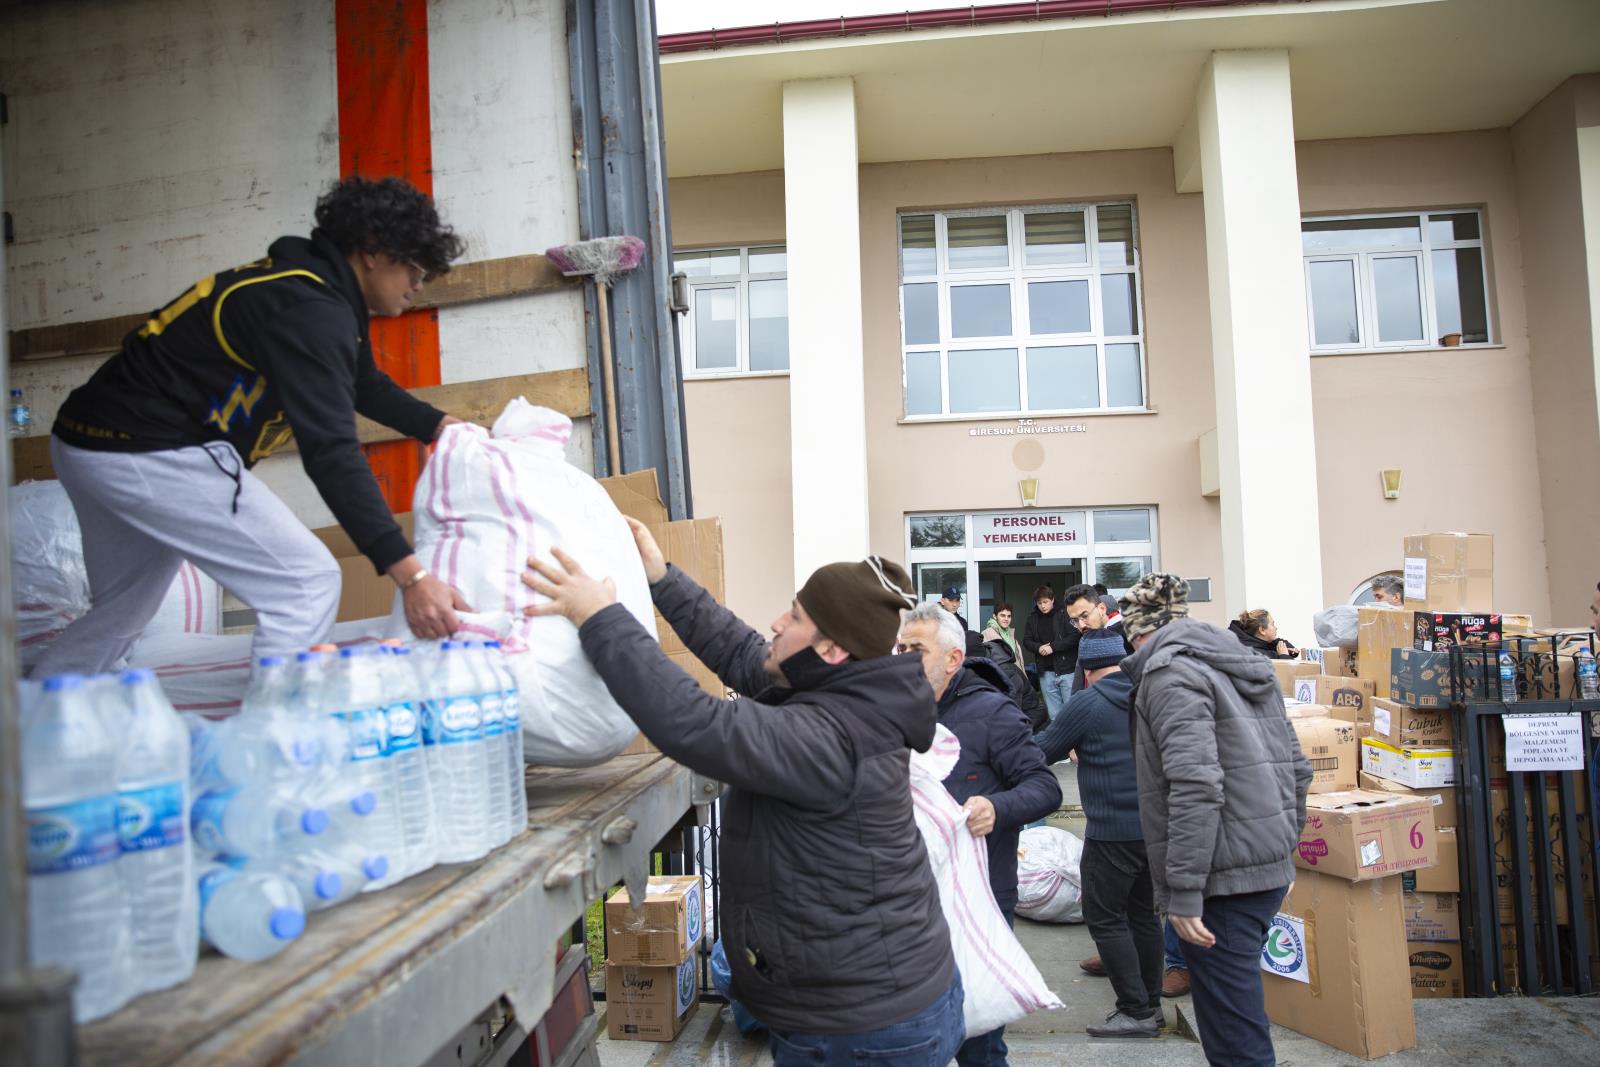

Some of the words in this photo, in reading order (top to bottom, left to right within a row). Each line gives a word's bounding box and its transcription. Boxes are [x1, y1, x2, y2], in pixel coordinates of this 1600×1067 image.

[993, 516, 1066, 527] PERSONEL
[983, 530, 1076, 543] YEMEKHANESİ
[1336, 692, 1361, 706] ABC
[1272, 962, 1290, 972] 2006
